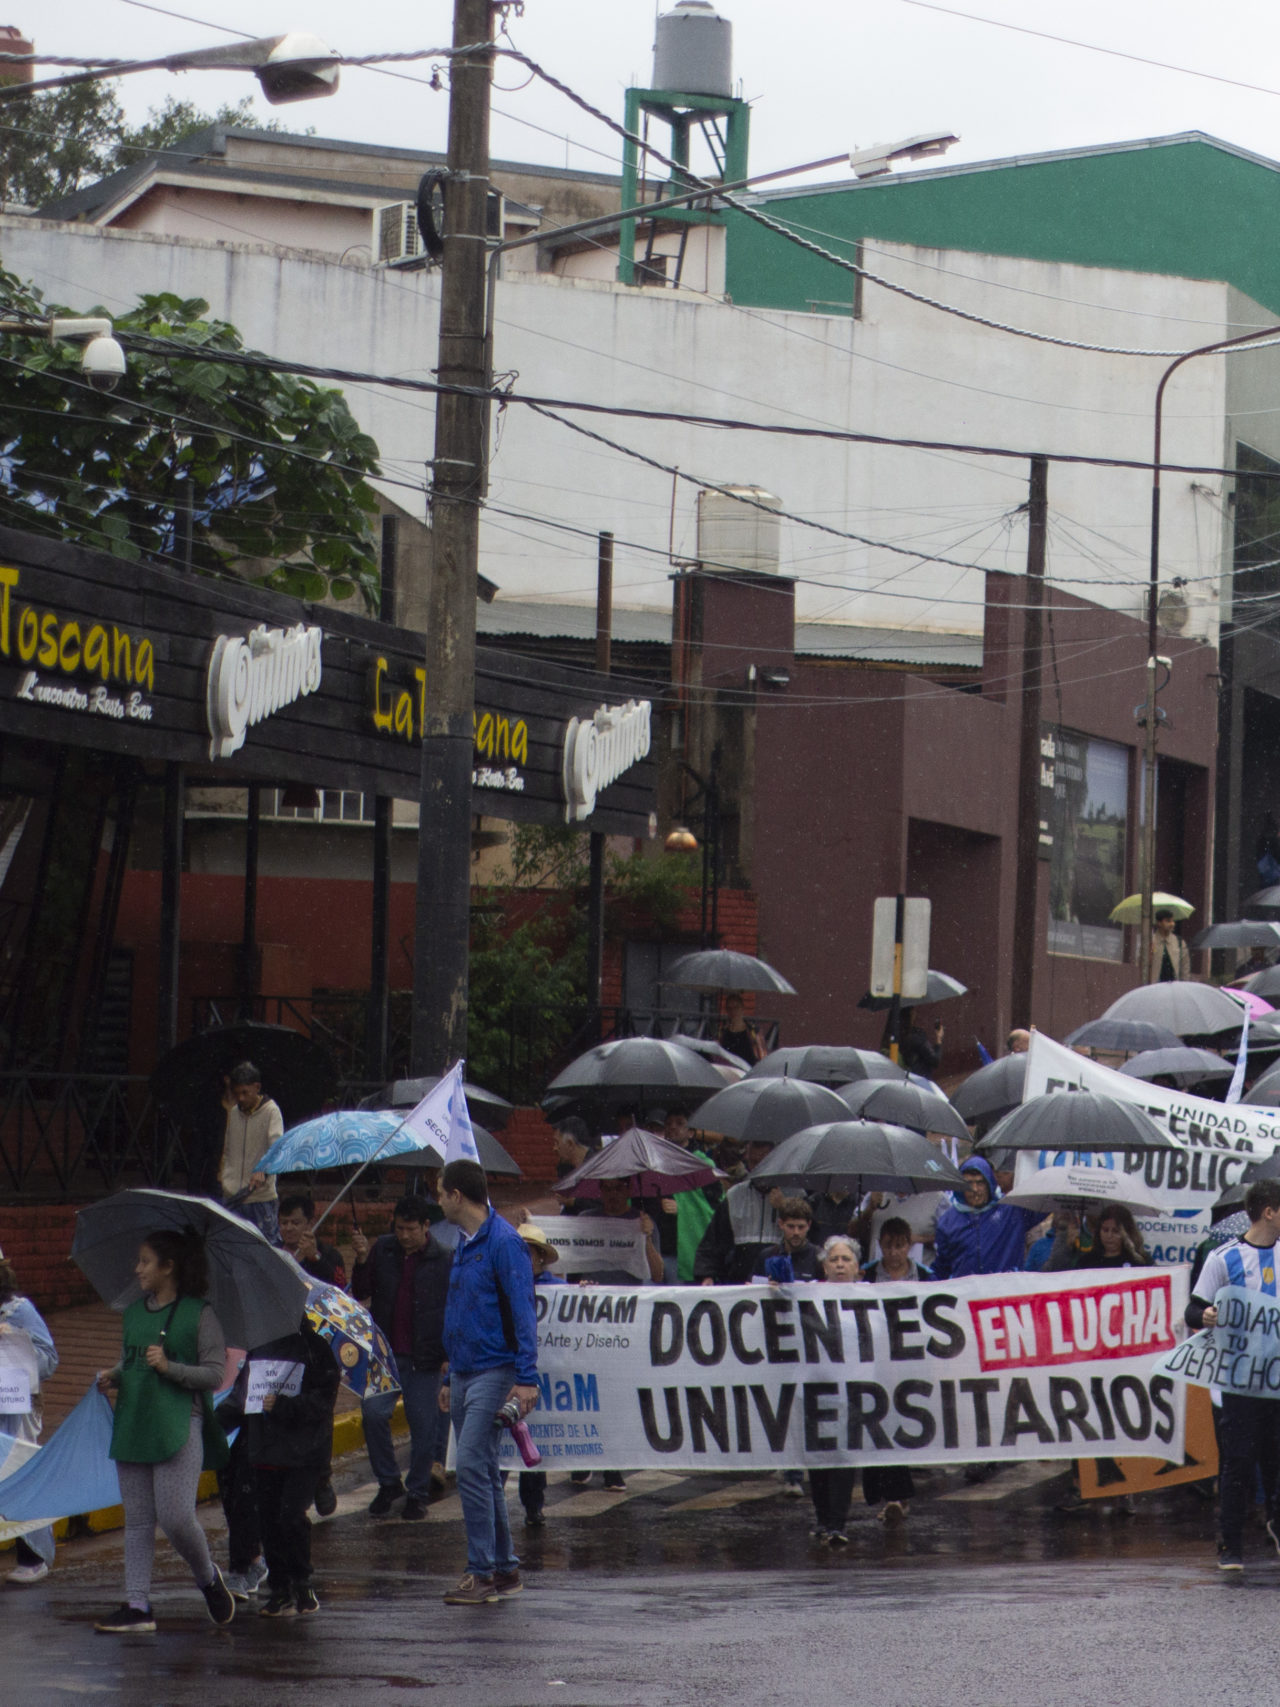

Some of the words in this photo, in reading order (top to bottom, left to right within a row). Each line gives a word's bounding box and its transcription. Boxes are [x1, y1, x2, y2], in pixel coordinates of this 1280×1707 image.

[127, 691, 153, 720] Bar
[373, 657, 412, 742] La
[1136, 1221, 1199, 1234] DOCENTES
[651, 1293, 966, 1367] DOCENTES
[978, 1303, 1037, 1362] EN
[1046, 1287, 1170, 1355] LUCHA
[544, 1332, 571, 1348] Arte
[574, 1335, 583, 1351] y
[586, 1331, 630, 1349] Diseño
[1227, 1334, 1249, 1351] TU
[635, 1375, 1175, 1453] UNIVERSITARIOS
[567, 1424, 581, 1438] DE
[583, 1424, 599, 1438] LA
